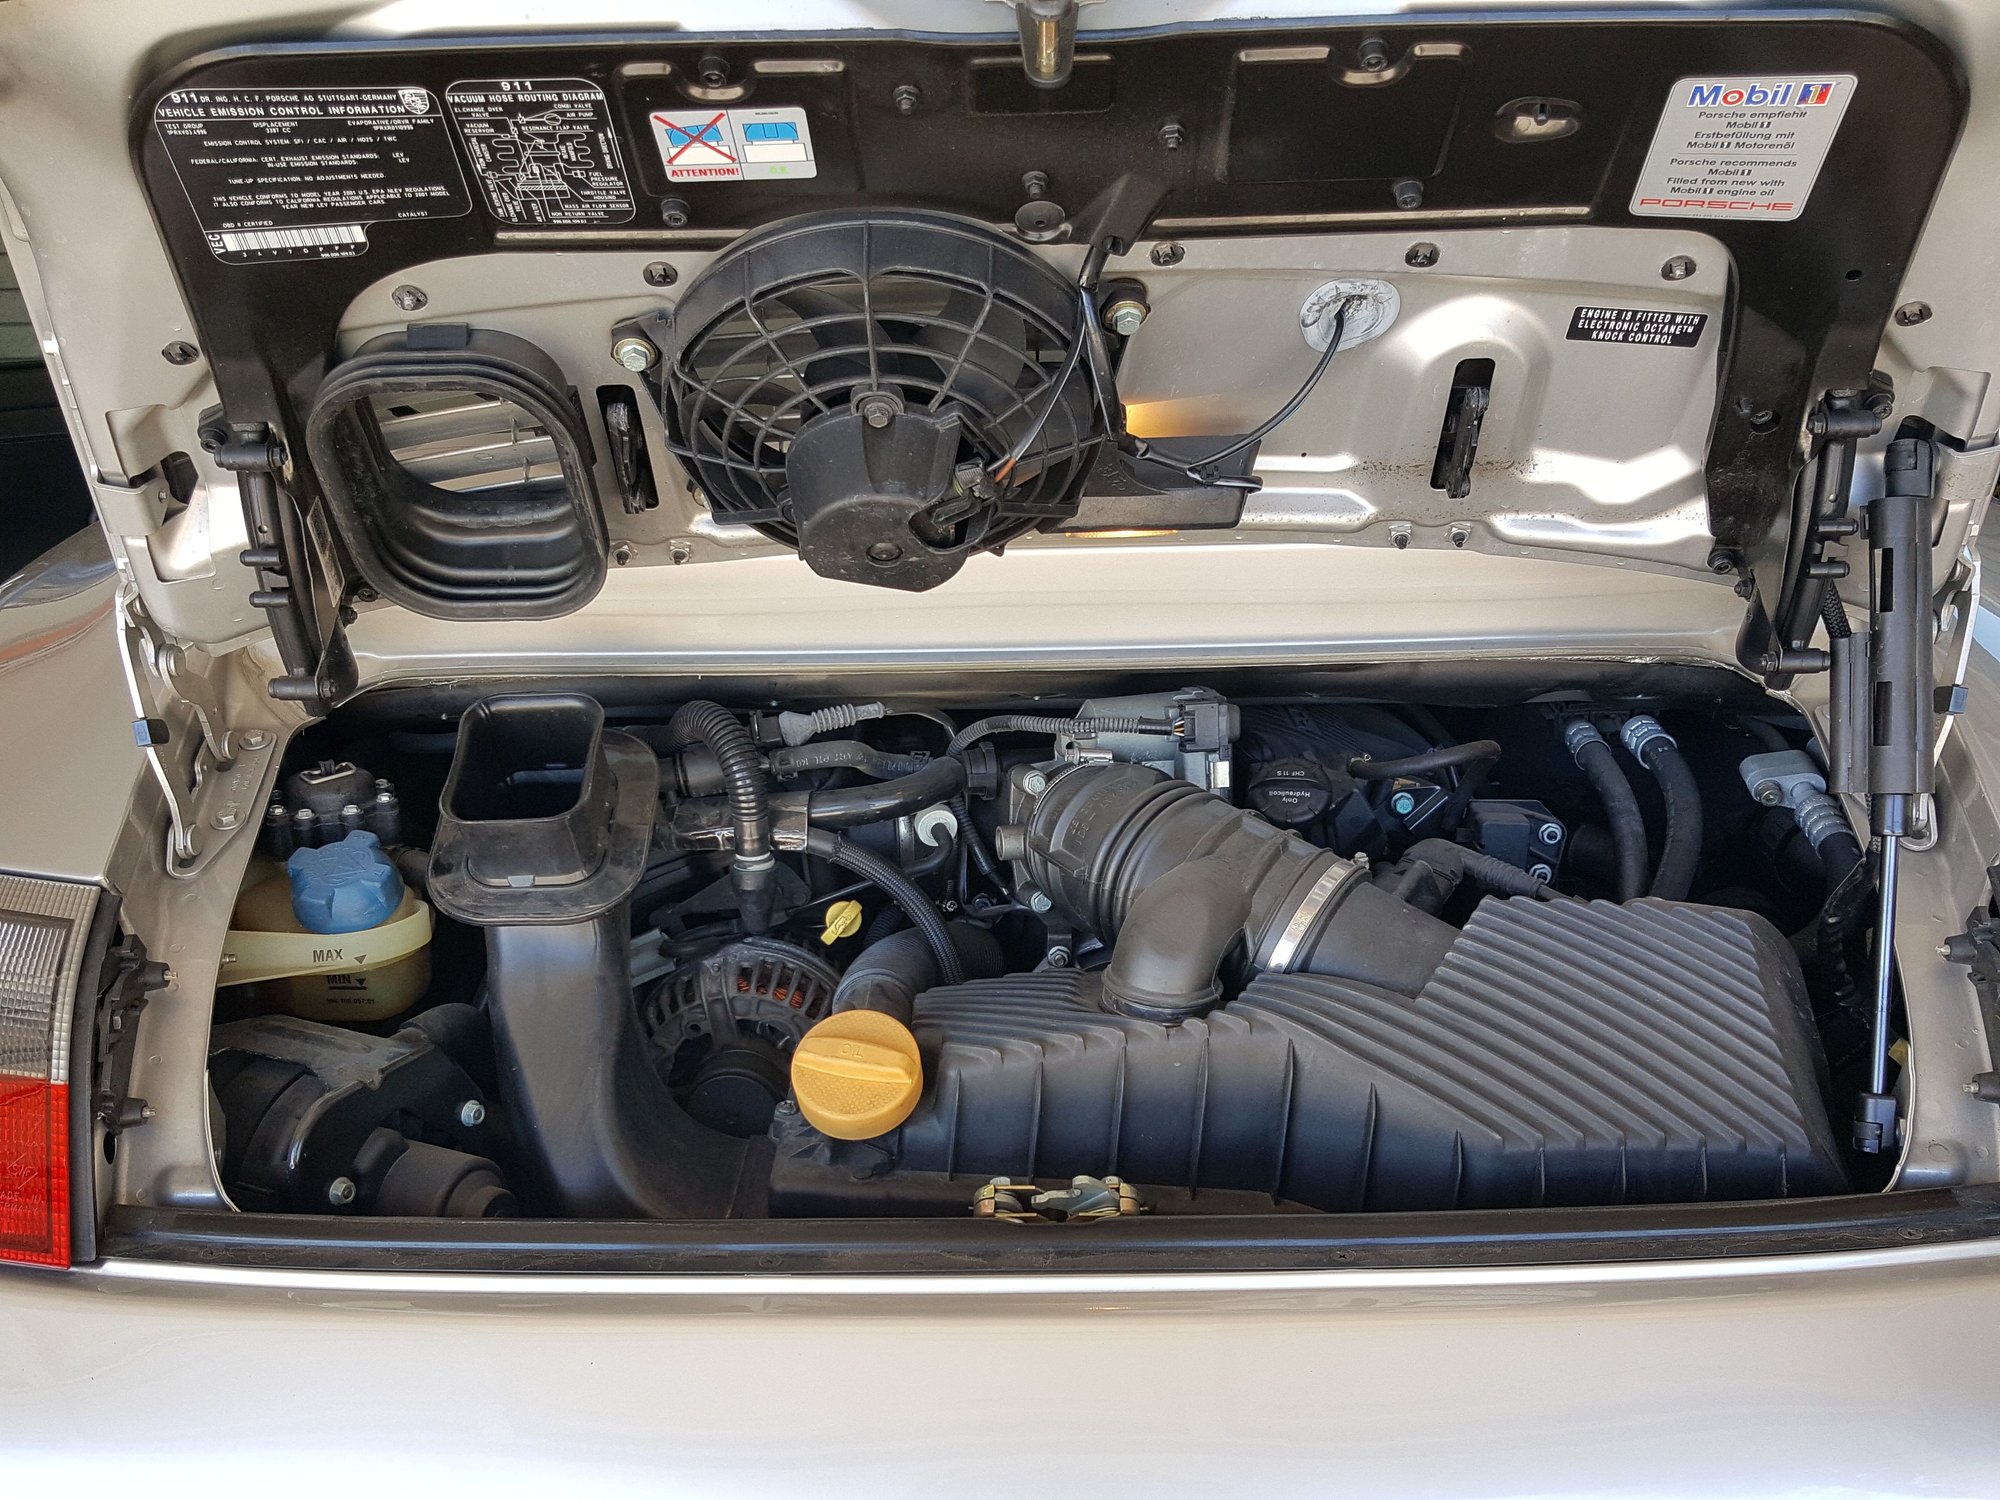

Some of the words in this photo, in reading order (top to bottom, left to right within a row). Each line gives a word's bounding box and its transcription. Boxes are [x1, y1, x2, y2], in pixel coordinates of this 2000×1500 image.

[501, 81, 532, 91] 911
[171, 92, 198, 104] 911
[447, 95, 486, 103] VACUUM
[489, 94, 514, 102] HOSE
[517, 93, 559, 102] ROUTING
[562, 92, 604, 101] DIAGRAM
[1687, 83, 1794, 107] Mobil
[158, 108, 206, 117] VEHICLE
[210, 107, 265, 116] EMISSION
[270, 106, 323, 116] CONTROL
[328, 105, 406, 115] INFORMATION
[1698, 111, 1746, 120] Porsche
[1750, 111, 1808, 121] empfiehlt
[1726, 121, 1759, 129] Mobil
[1694, 131, 1772, 140] Erstbefüllung
[1776, 132, 1795, 140] mit
[1687, 141, 1719, 149] Mobil
[1734, 141, 1794, 149] Motorenöl
[1670, 158, 1716, 166] Porsche
[1720, 159, 1797, 167] recommends
[671, 168, 740, 177] ATTENTION!
[1708, 168, 1740, 176] Mobil
[1667, 177, 1698, 185] Filled
[1701, 178, 1728, 186] from
[1731, 179, 1757, 187] new
[1760, 179, 1785, 187] with
[1670, 187, 1702, 195] Mobil
[1716, 188, 1757, 197] engine
[1760, 188, 1775, 196] oil
[1640, 198, 1794, 211] PORSCHE
[208, 233, 227, 255] VEC
[1580, 308, 1619, 320] ENGINE
[1621, 311, 1632, 321] IS
[1636, 312, 1671, 324] FITTED
[1675, 314, 1700, 325] WITH
[1578, 319, 1640, 332] ELECTRONIC
[1591, 330, 1625, 342] KNOCK
[1629, 332, 1672, 344] CONTROL
[1281, 796, 1298, 804] Only
[312, 948, 344, 963] MAX
[327, 975, 352, 985] MIN
[841, 1043, 864, 1059] OIL
